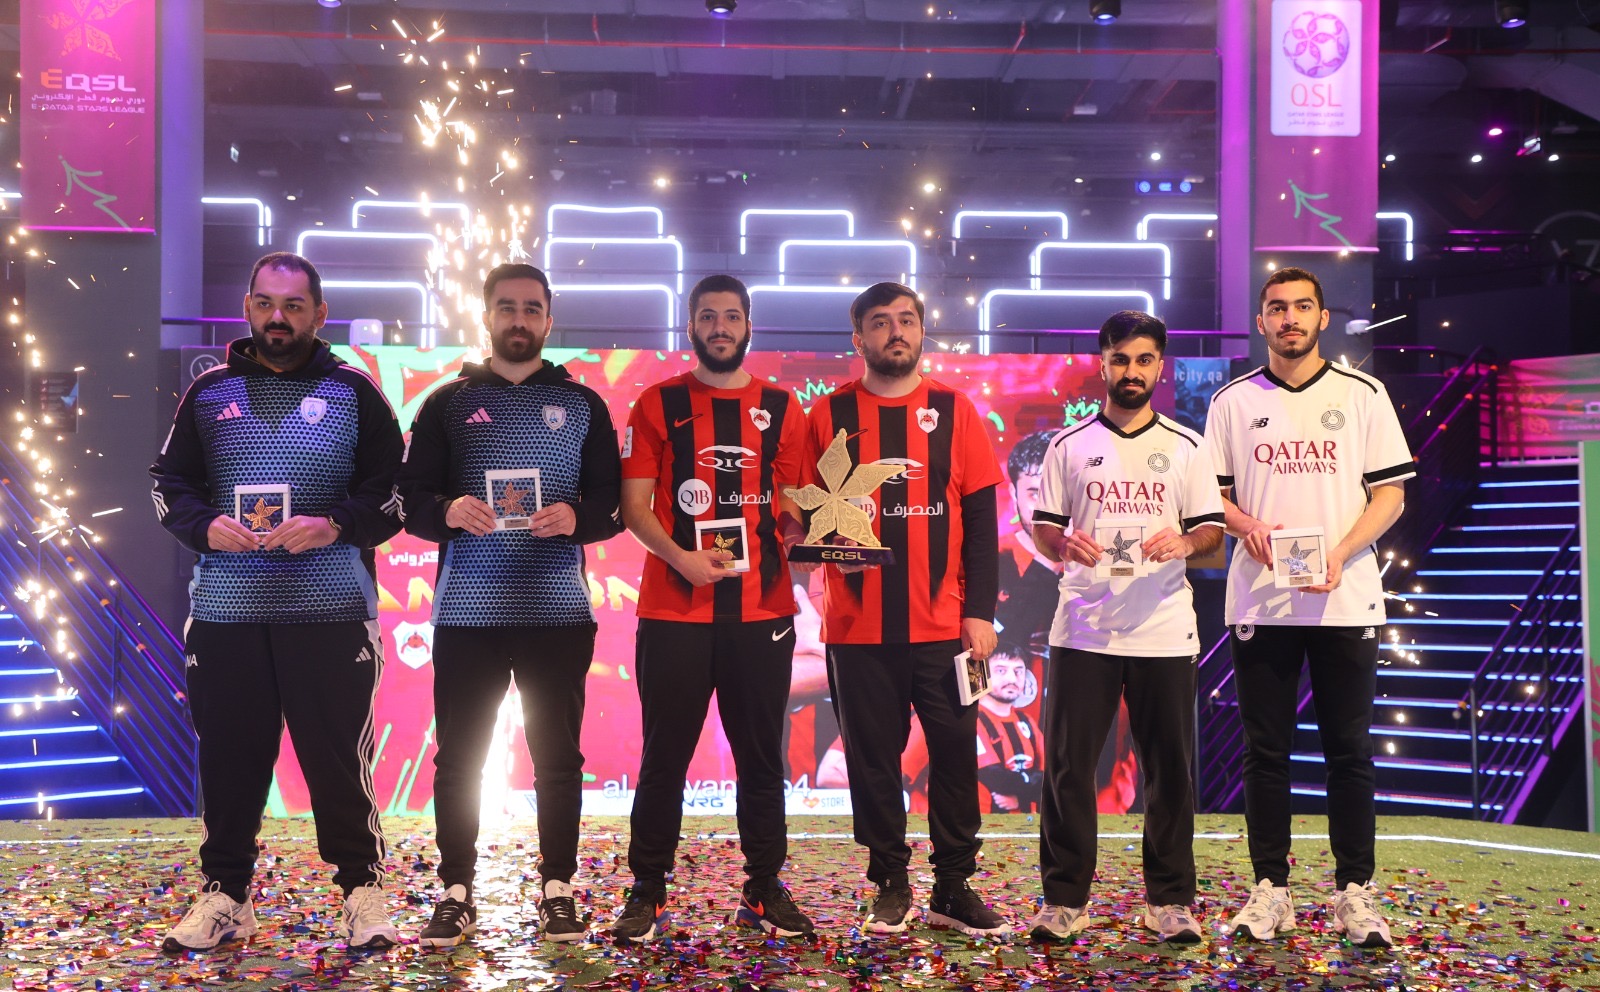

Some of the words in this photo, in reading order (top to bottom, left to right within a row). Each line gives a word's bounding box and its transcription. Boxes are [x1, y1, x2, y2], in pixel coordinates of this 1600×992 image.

[40, 68, 137, 92] EQSL
[1291, 82, 1342, 108] QSL
[77, 105, 108, 113] STARS
[109, 106, 145, 114] LEAGUE
[1254, 440, 1337, 466] QATAR
[698, 456, 758, 473] QIC
[1273, 461, 1337, 475] AIRWAYS
[681, 490, 710, 507] QIB
[718, 490, 772, 507] المصرف
[1086, 481, 1166, 504] QATAR
[883, 501, 944, 518] المصرف
[1102, 501, 1164, 517] AIRWAYS
[821, 550, 866, 561] EQSL
[821, 797, 846, 808] STORE
